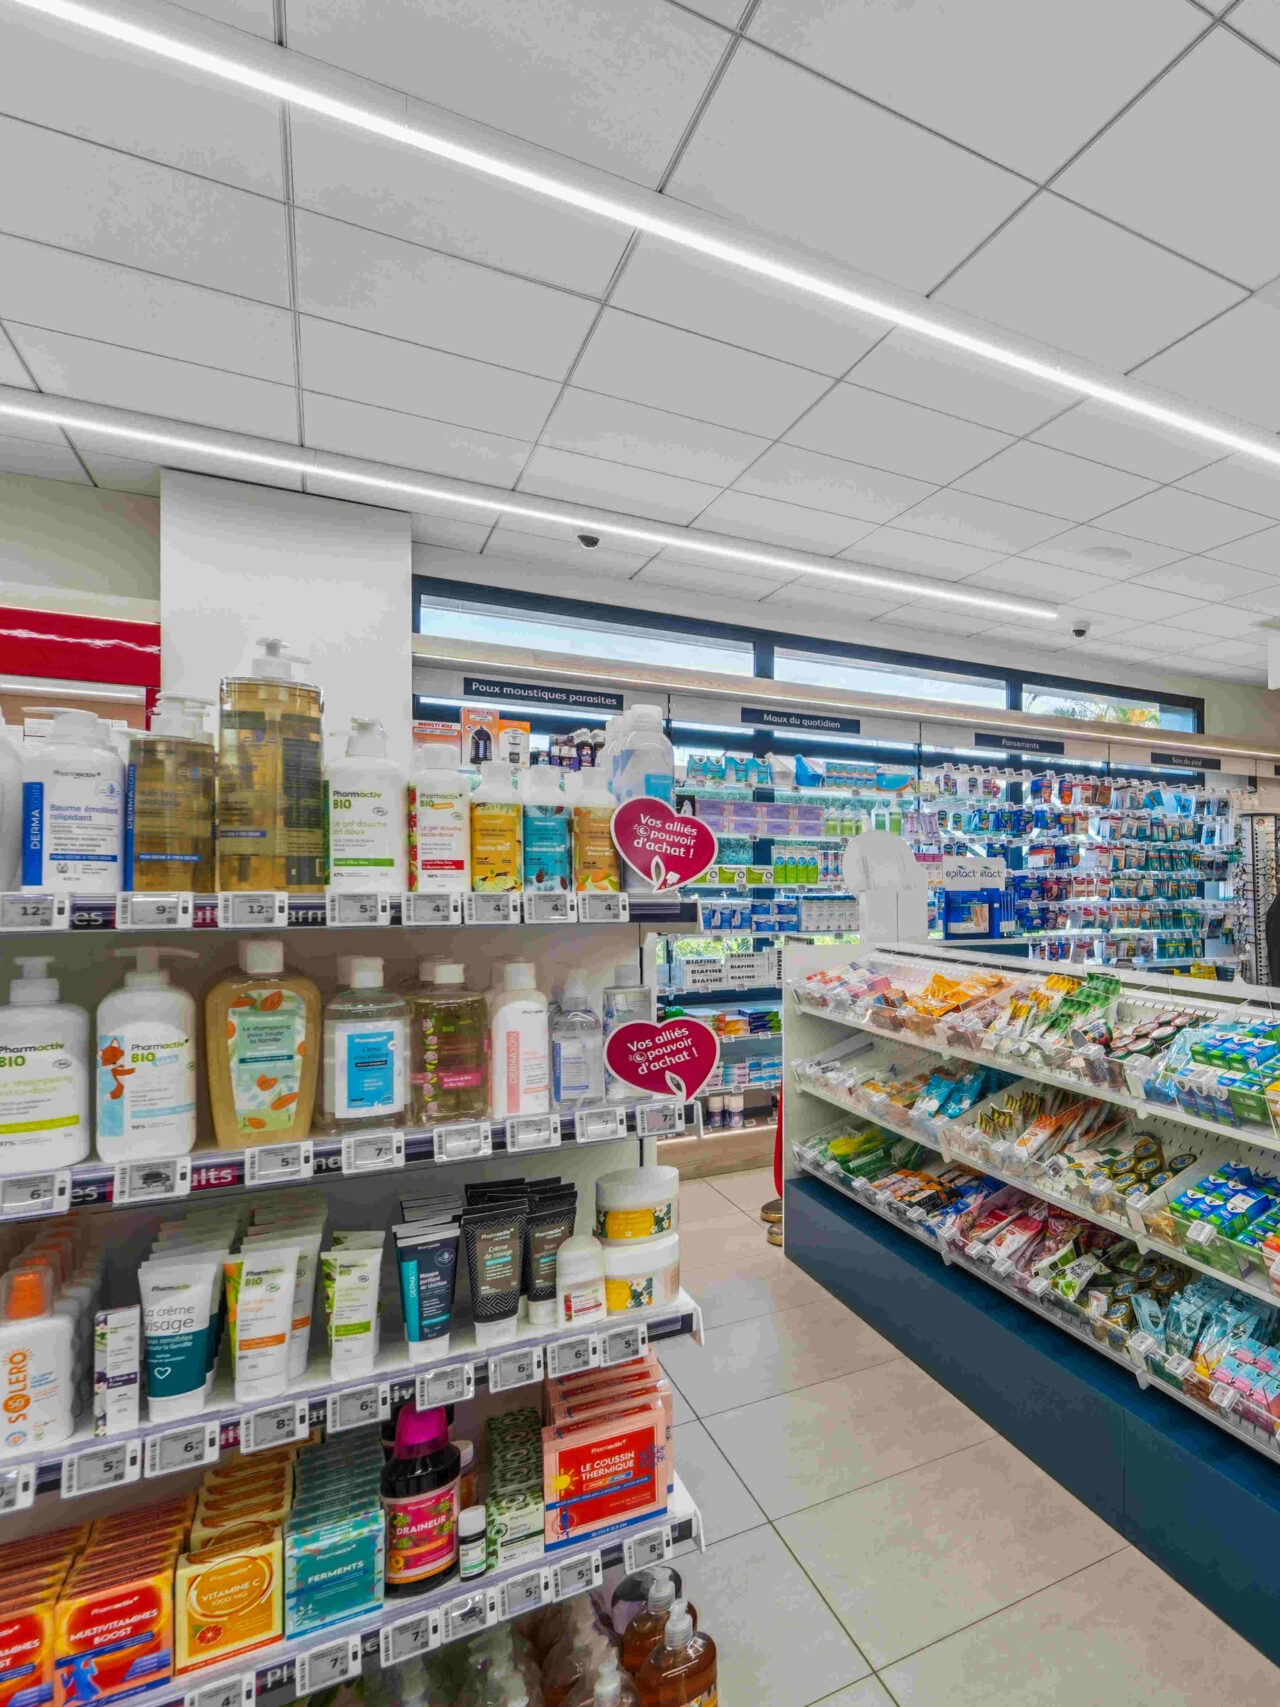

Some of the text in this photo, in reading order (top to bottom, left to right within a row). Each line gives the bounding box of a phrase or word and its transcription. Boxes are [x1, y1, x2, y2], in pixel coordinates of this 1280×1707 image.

[471, 681, 617, 707] Poux moustiques parasites
[764, 713, 841, 729] Maux du quotidien
[333, 799, 352, 809] BIO
[639, 813, 699, 837] Vos alliés
[634, 835, 684, 857] d'achat
[650, 827, 696, 847] pouvoir
[131, 1039, 185, 1051] Pharmactiv
[627, 1027, 689, 1052] Vos alliés
[645, 1038, 693, 1062] pouvoir
[131, 1052, 156, 1063] BIO
[637, 1052, 689, 1076] d'achat
[157, 1305, 195, 1316] crème
[580, 1451, 636, 1473] LE COUSSIN
[580, 1459, 636, 1481] THERMIQUE
[396, 1516, 447, 1536] DRAINEUR
[307, 1560, 365, 1584] FERMENTS
[201, 1578, 261, 1602] VITAMINE C
[70, 1609, 158, 1641] MULTIVITAMINES
[94, 1626, 132, 1645] BOOST
